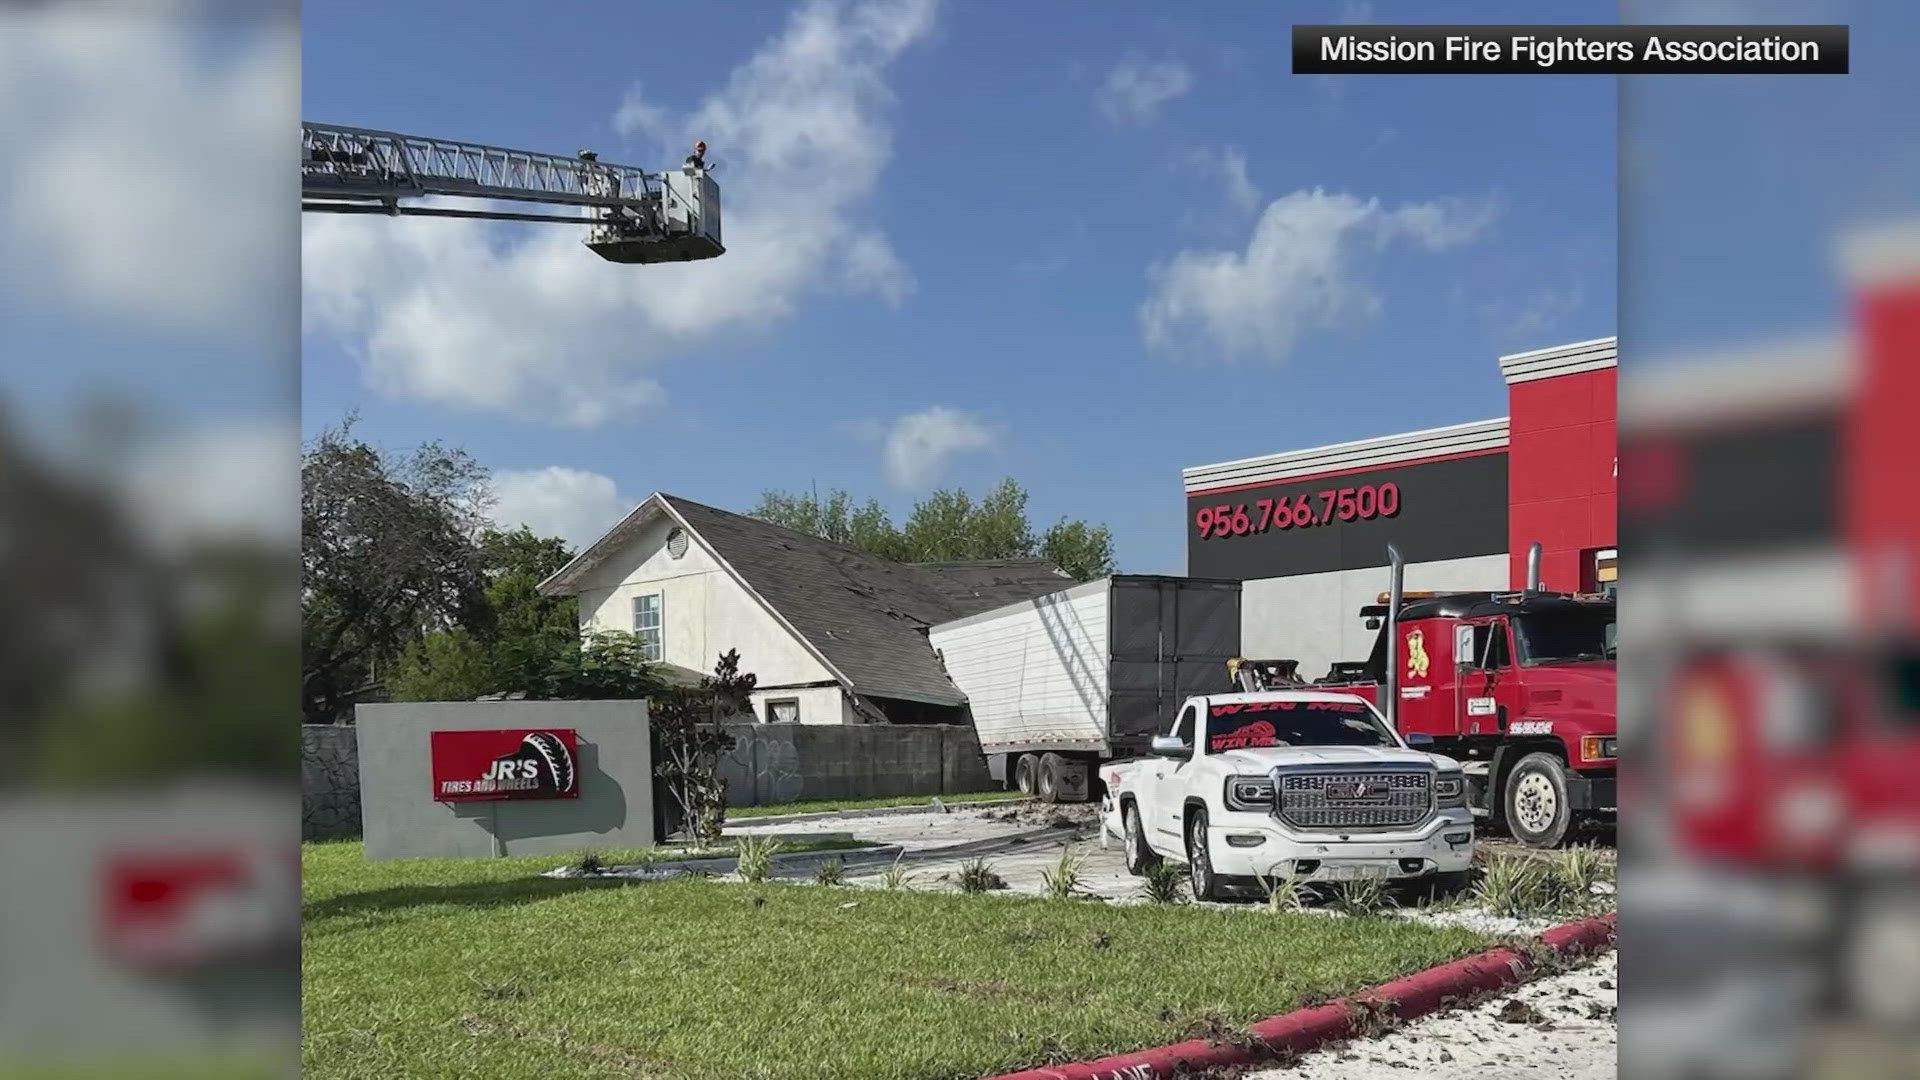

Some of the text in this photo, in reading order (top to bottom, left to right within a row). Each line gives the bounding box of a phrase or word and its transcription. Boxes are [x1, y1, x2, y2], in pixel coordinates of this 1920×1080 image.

[1196, 482, 1399, 538] 956.766.7500
[481, 759, 539, 780] JR'S
[441, 778, 540, 793] TIRES AND WHEELS
